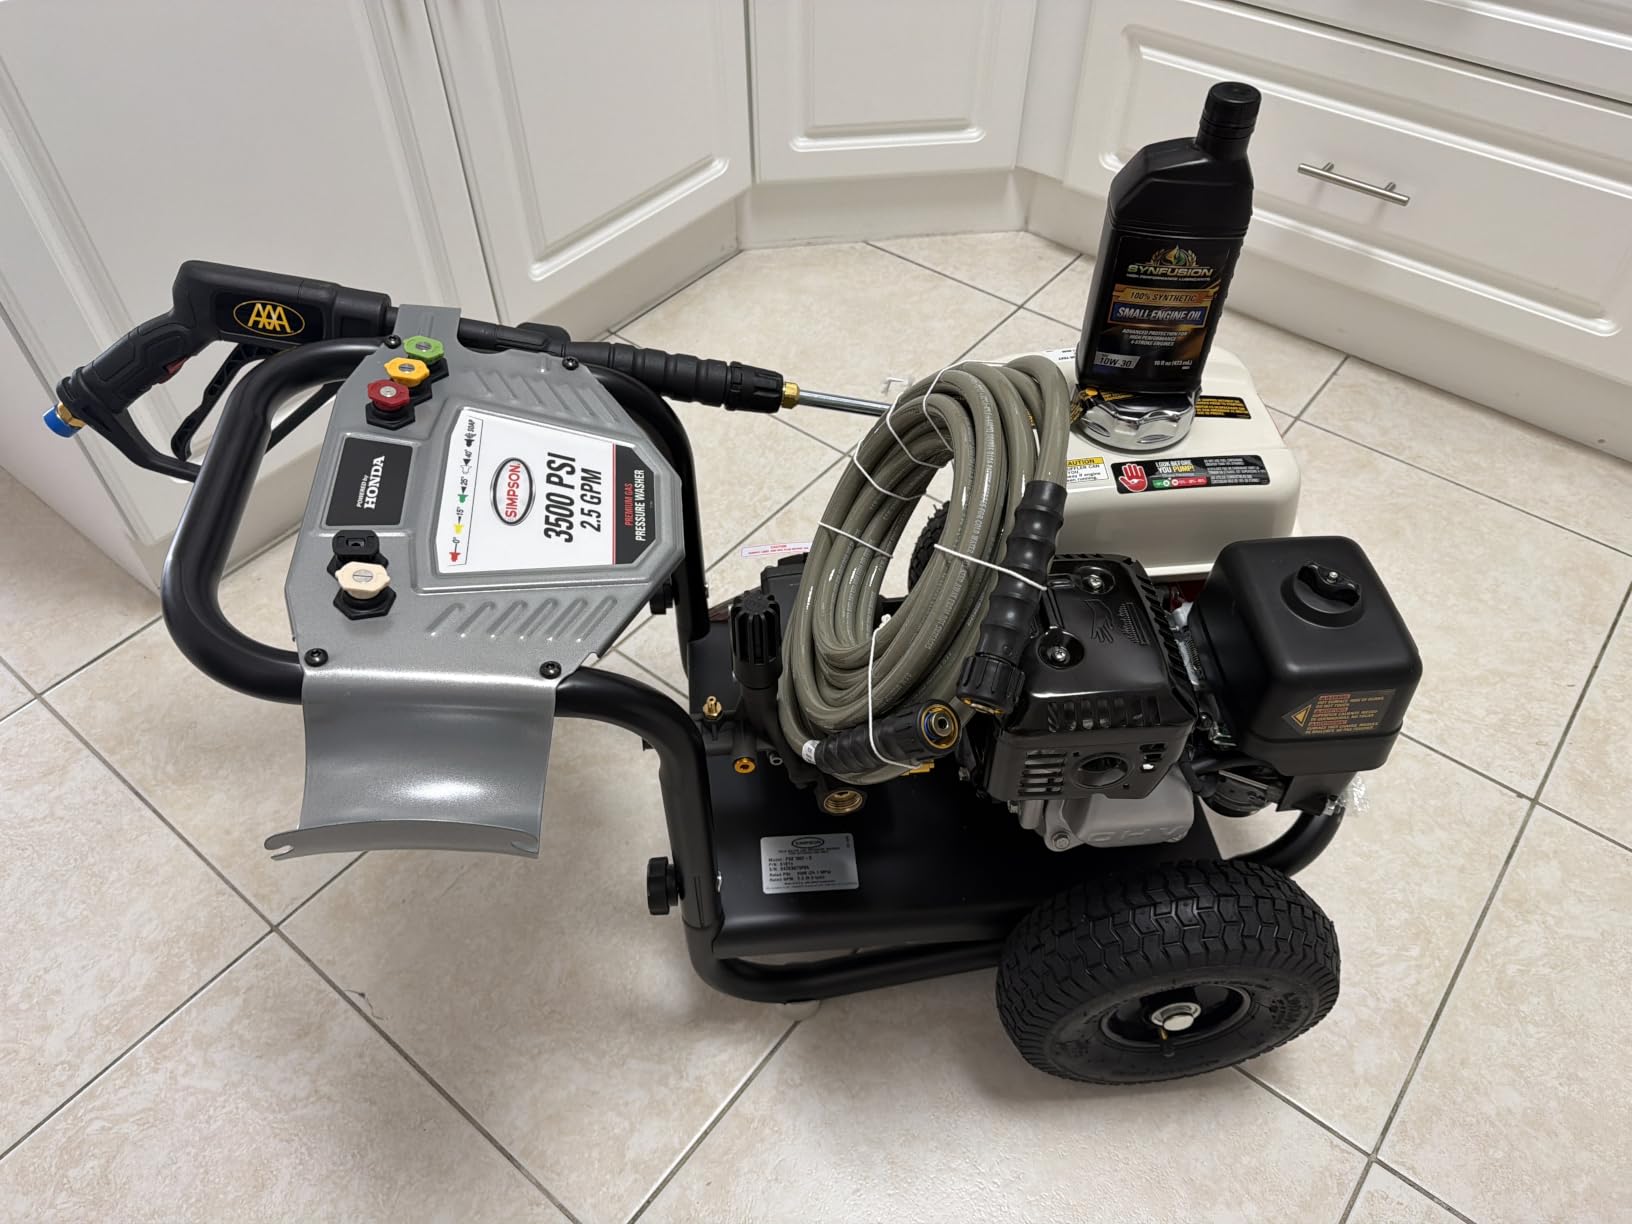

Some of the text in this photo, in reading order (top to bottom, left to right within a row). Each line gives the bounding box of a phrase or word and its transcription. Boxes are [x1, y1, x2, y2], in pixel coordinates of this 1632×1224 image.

[1127, 264, 1214, 276] SYNFUSION
[1117, 307, 1201, 320] SMALL ENGINE OIL
[1130, 292, 1197, 302] 100% SYNTHETIC
[248, 303, 292, 333] AAA
[1100, 357, 1132, 367] 10W-30
[468, 419, 476, 433] SOAP
[356, 480, 367, 508] POWERED
[364, 456, 385, 509] HONDA
[505, 464, 522, 518] SIMPSON
[544, 452, 576, 543] 3500 PSI
[580, 468, 602, 532] 2.5 GPM
[624, 483, 633, 526] PREMIUM GAS
[635, 469, 646, 542] PRESSURE WASHER
[967, 508, 986, 554] FOR COLD WATER
